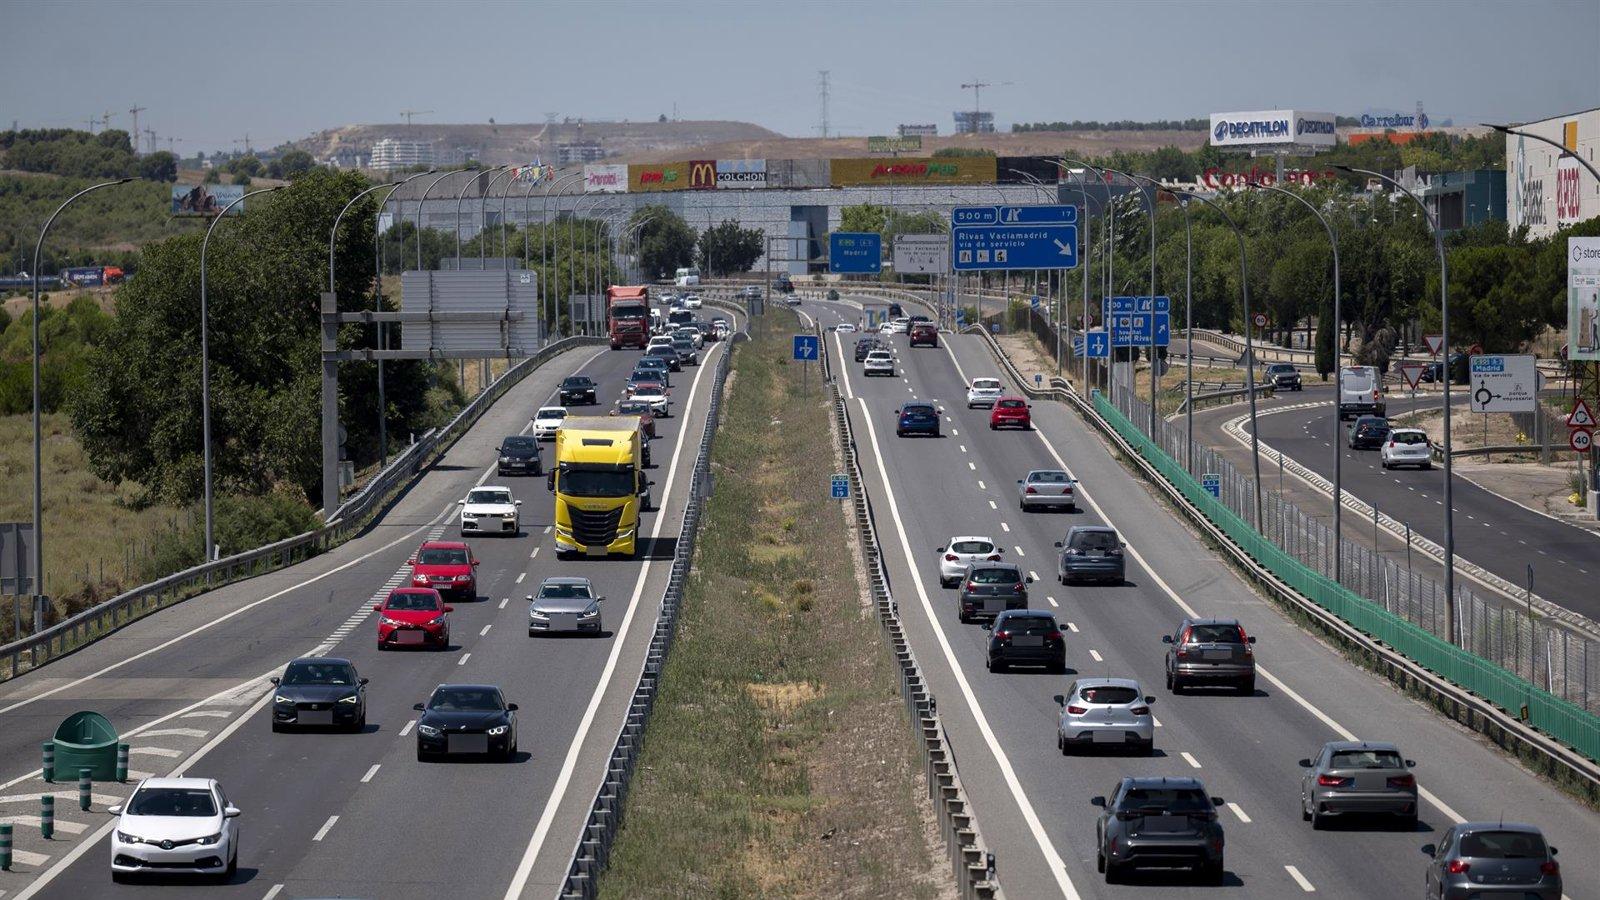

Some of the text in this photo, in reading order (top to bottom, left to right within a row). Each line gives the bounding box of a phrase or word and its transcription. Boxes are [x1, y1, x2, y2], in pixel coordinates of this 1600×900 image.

[1360, 114, 1415, 127] Carrefour
[1229, 120, 1289, 136] DECATHLON
[1305, 120, 1334, 134] DECATHLON
[717, 173, 765, 181] COLCHON
[959, 212, 980, 220] 500
[989, 232, 1048, 240] Vaciamadrid
[1574, 436, 1589, 445] 40
